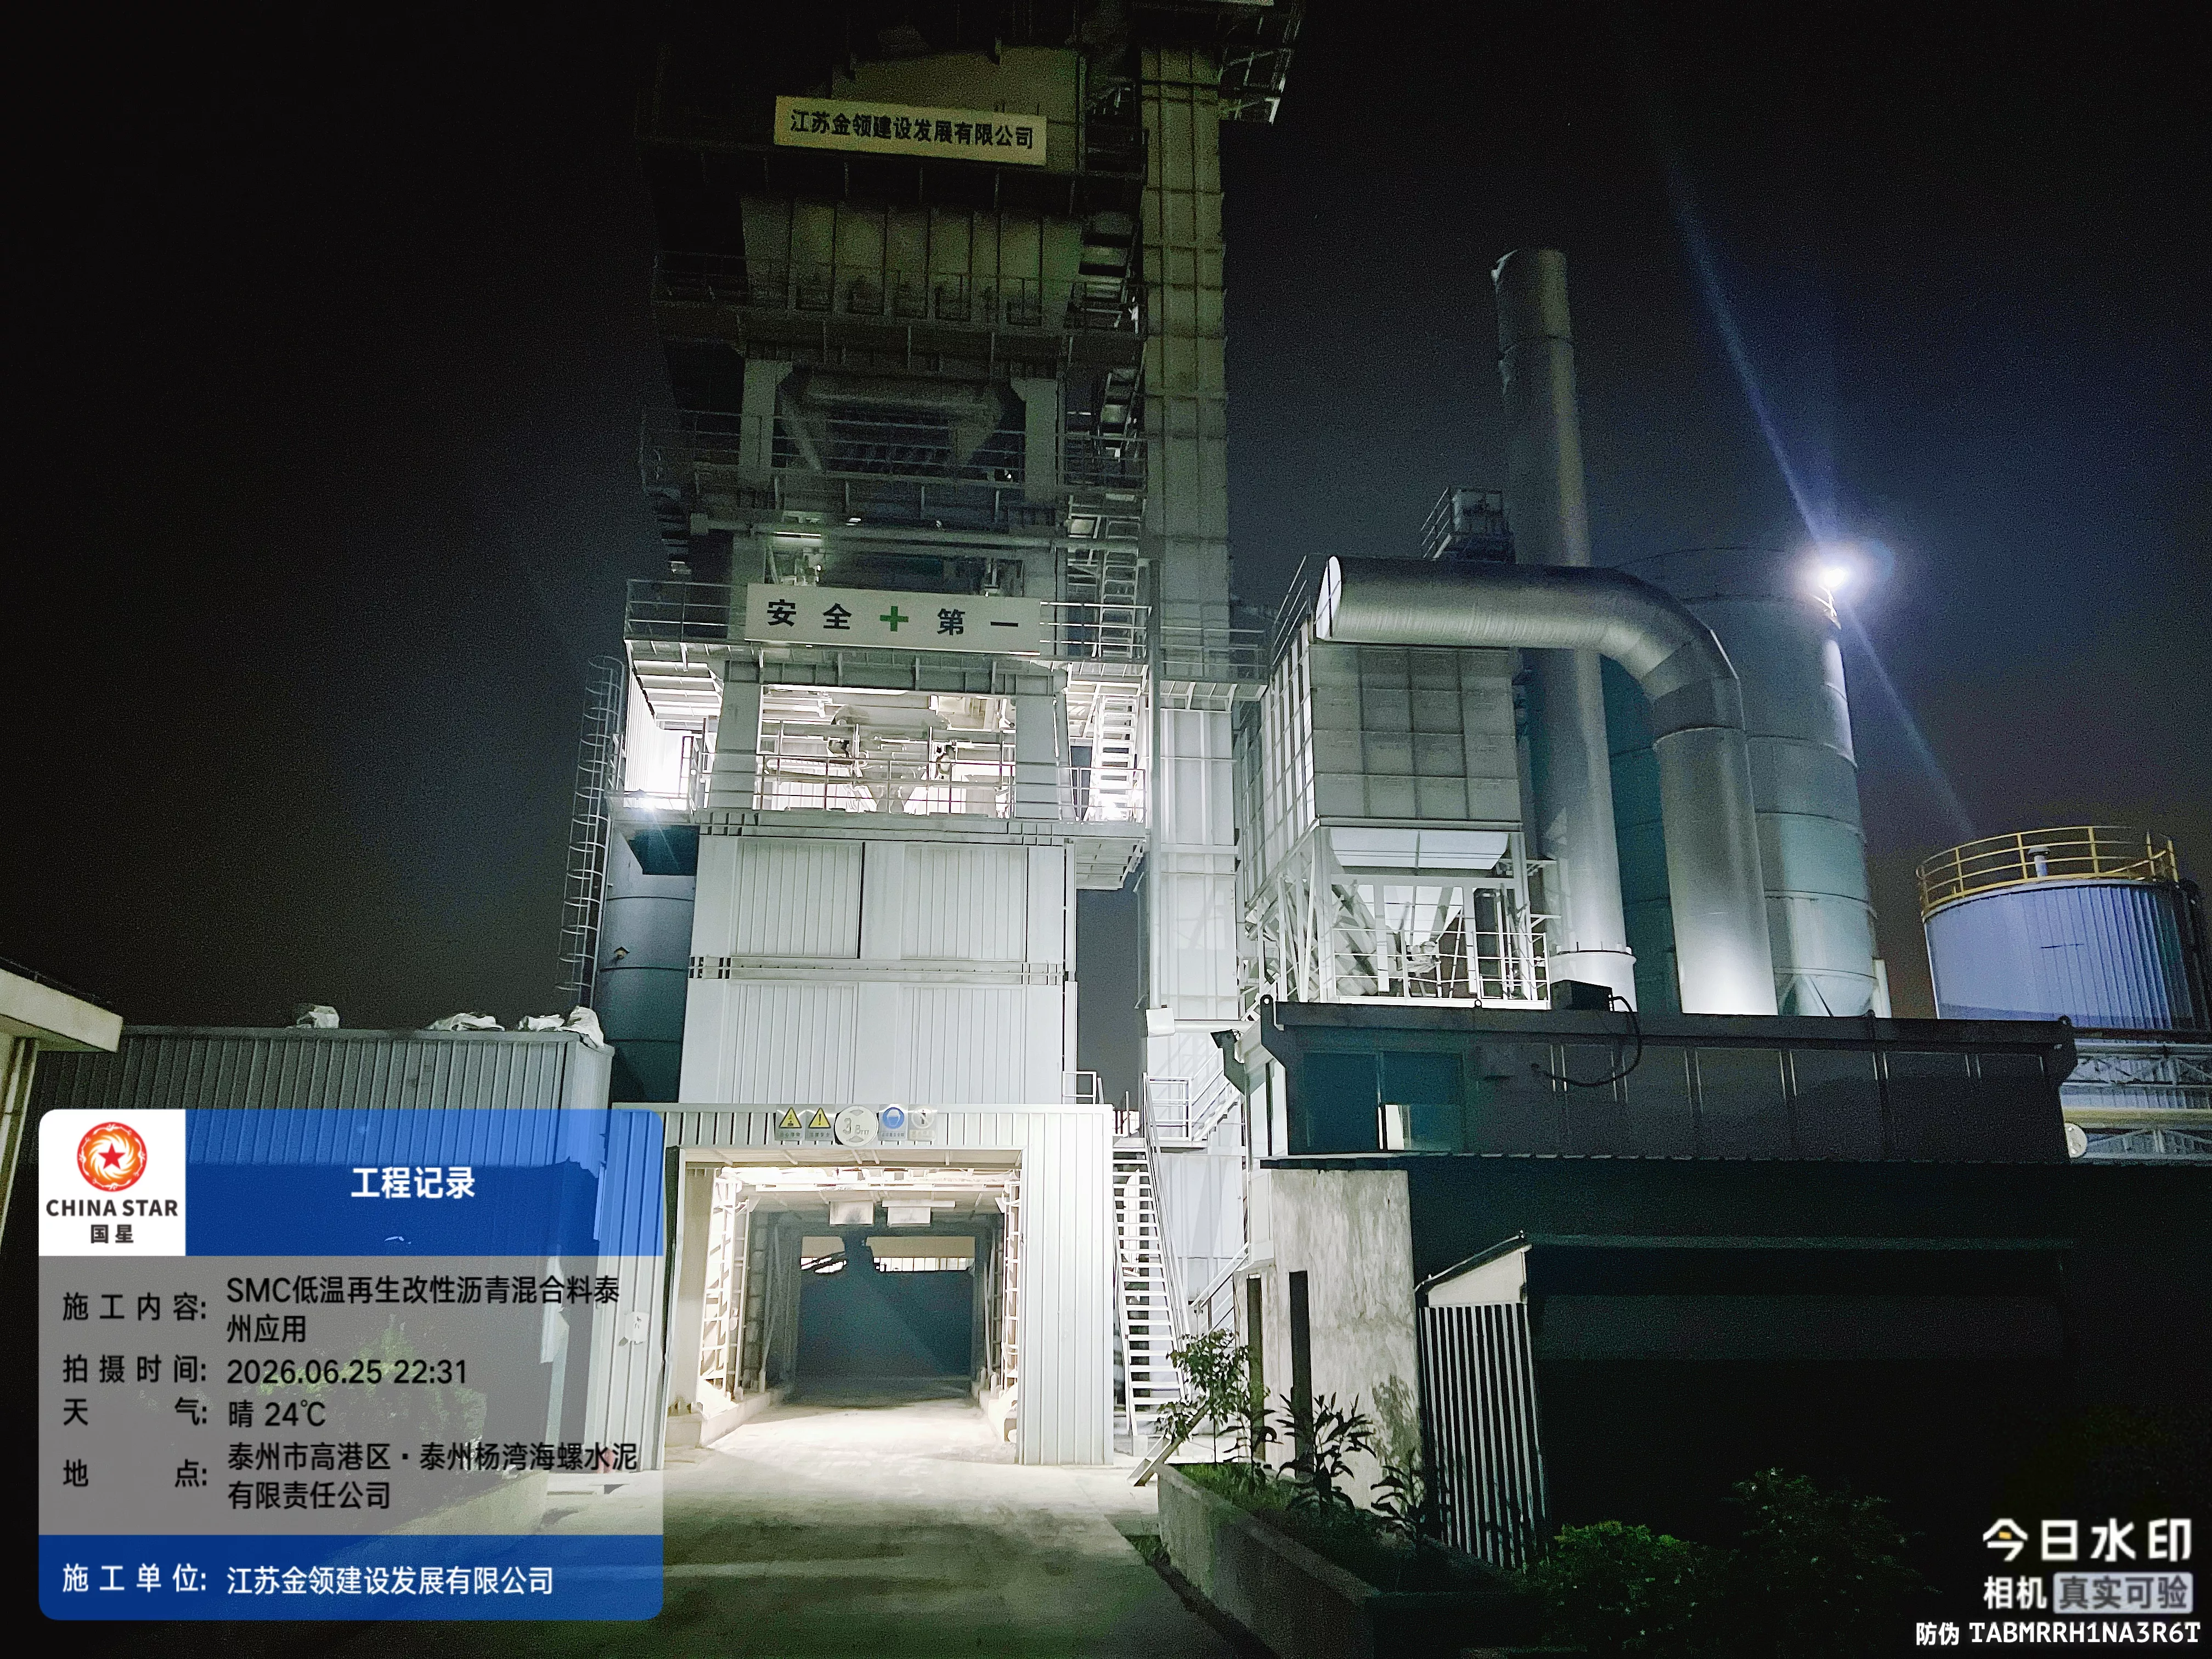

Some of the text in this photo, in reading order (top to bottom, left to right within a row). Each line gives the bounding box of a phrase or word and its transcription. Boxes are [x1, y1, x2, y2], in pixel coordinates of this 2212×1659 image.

[790, 109, 1033, 150] 江苏金领建设发展有限公司
